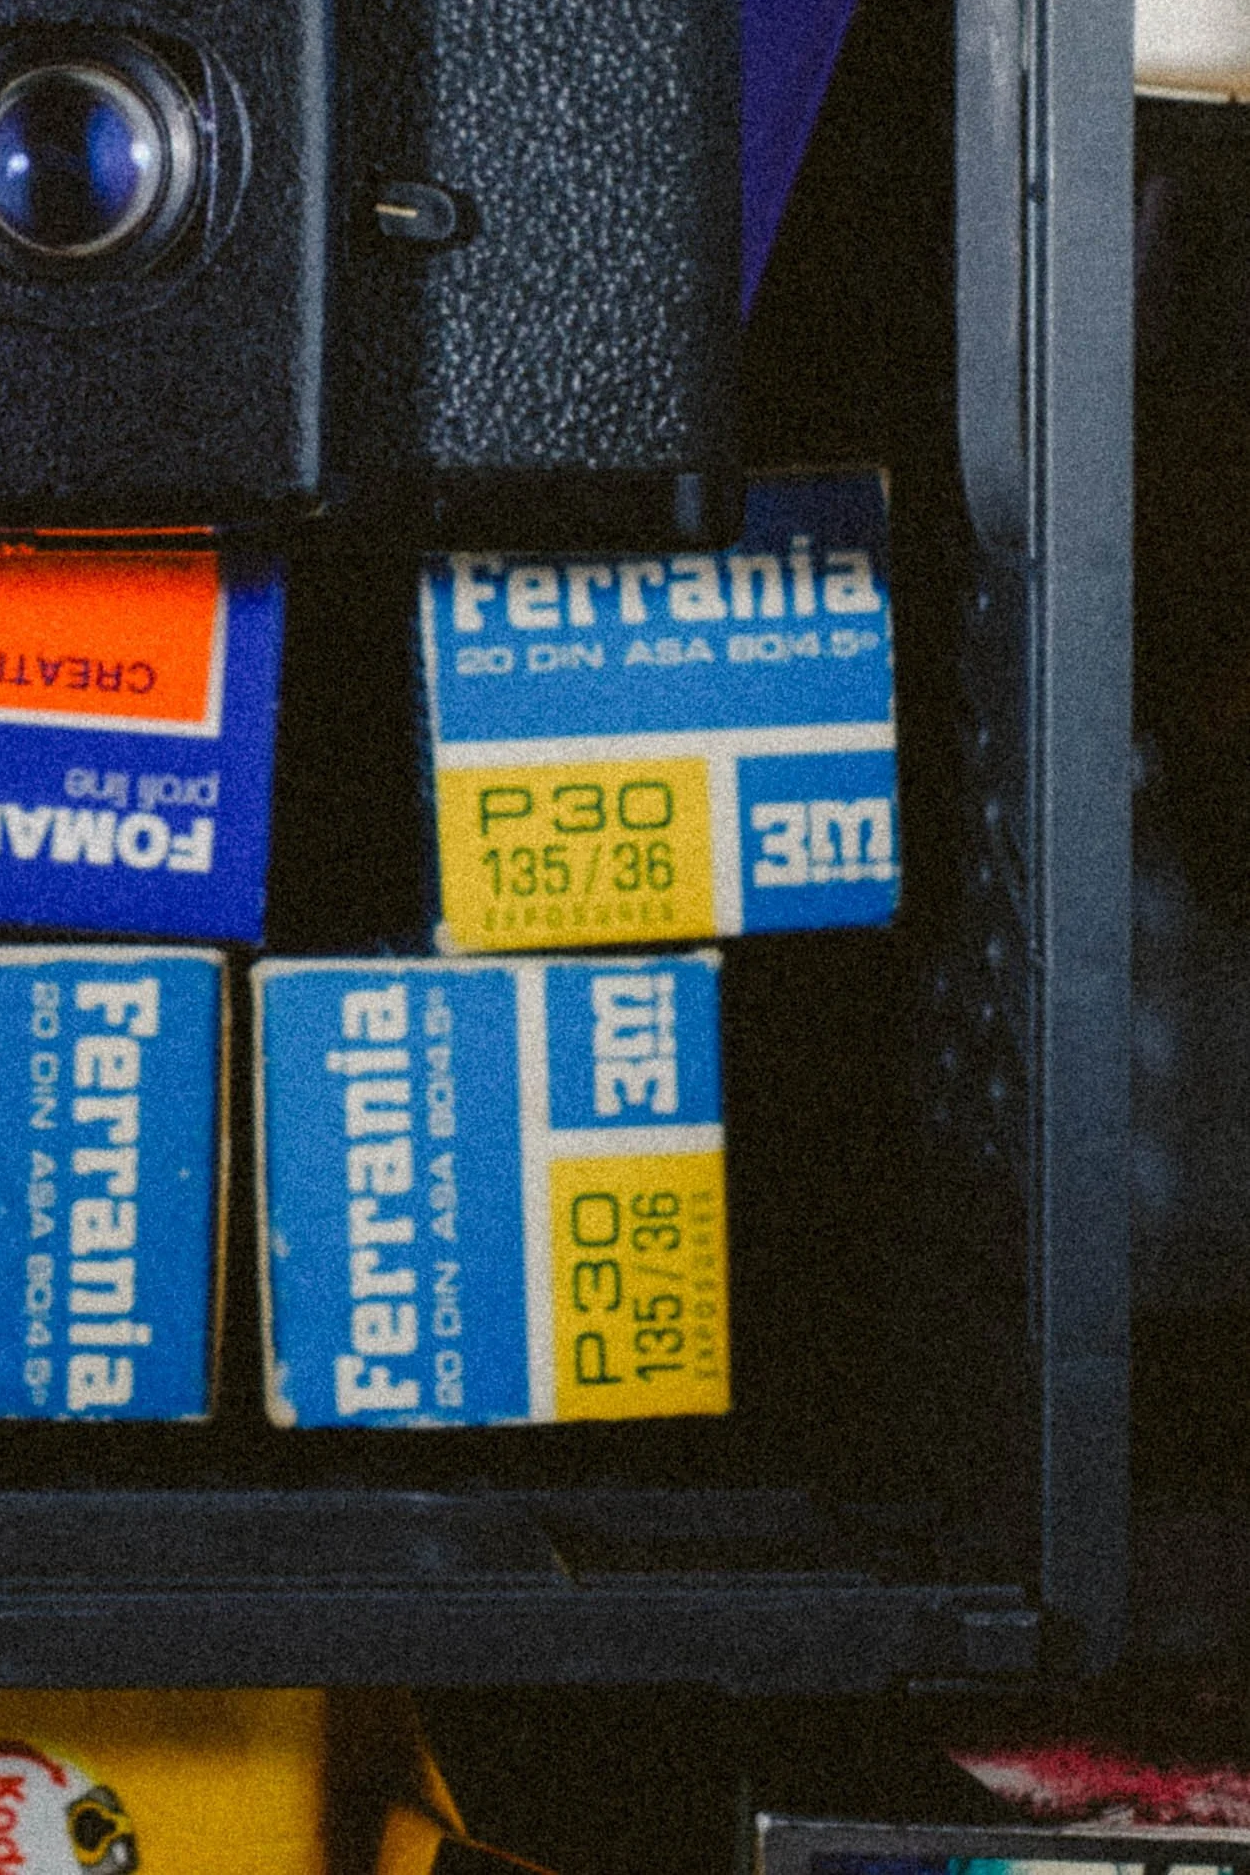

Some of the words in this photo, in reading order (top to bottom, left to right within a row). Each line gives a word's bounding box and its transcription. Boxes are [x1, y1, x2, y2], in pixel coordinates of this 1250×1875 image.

[452, 536, 883, 633] Ferrania
[456, 645, 516, 676] 20
[526, 642, 606, 674] DIN
[623, 636, 716, 667] ASA
[64, 766, 130, 806] line
[31, 982, 61, 1039] 20
[30, 1051, 59, 1130] DIN
[28, 1149, 58, 1241] ASA
[66, 977, 161, 1411] Ferrania
[325, 982, 421, 1417] Ferrania
[427, 1152, 459, 1242] ASA
[433, 1261, 463, 1339] DIN
[434, 1349, 464, 1408] 20
